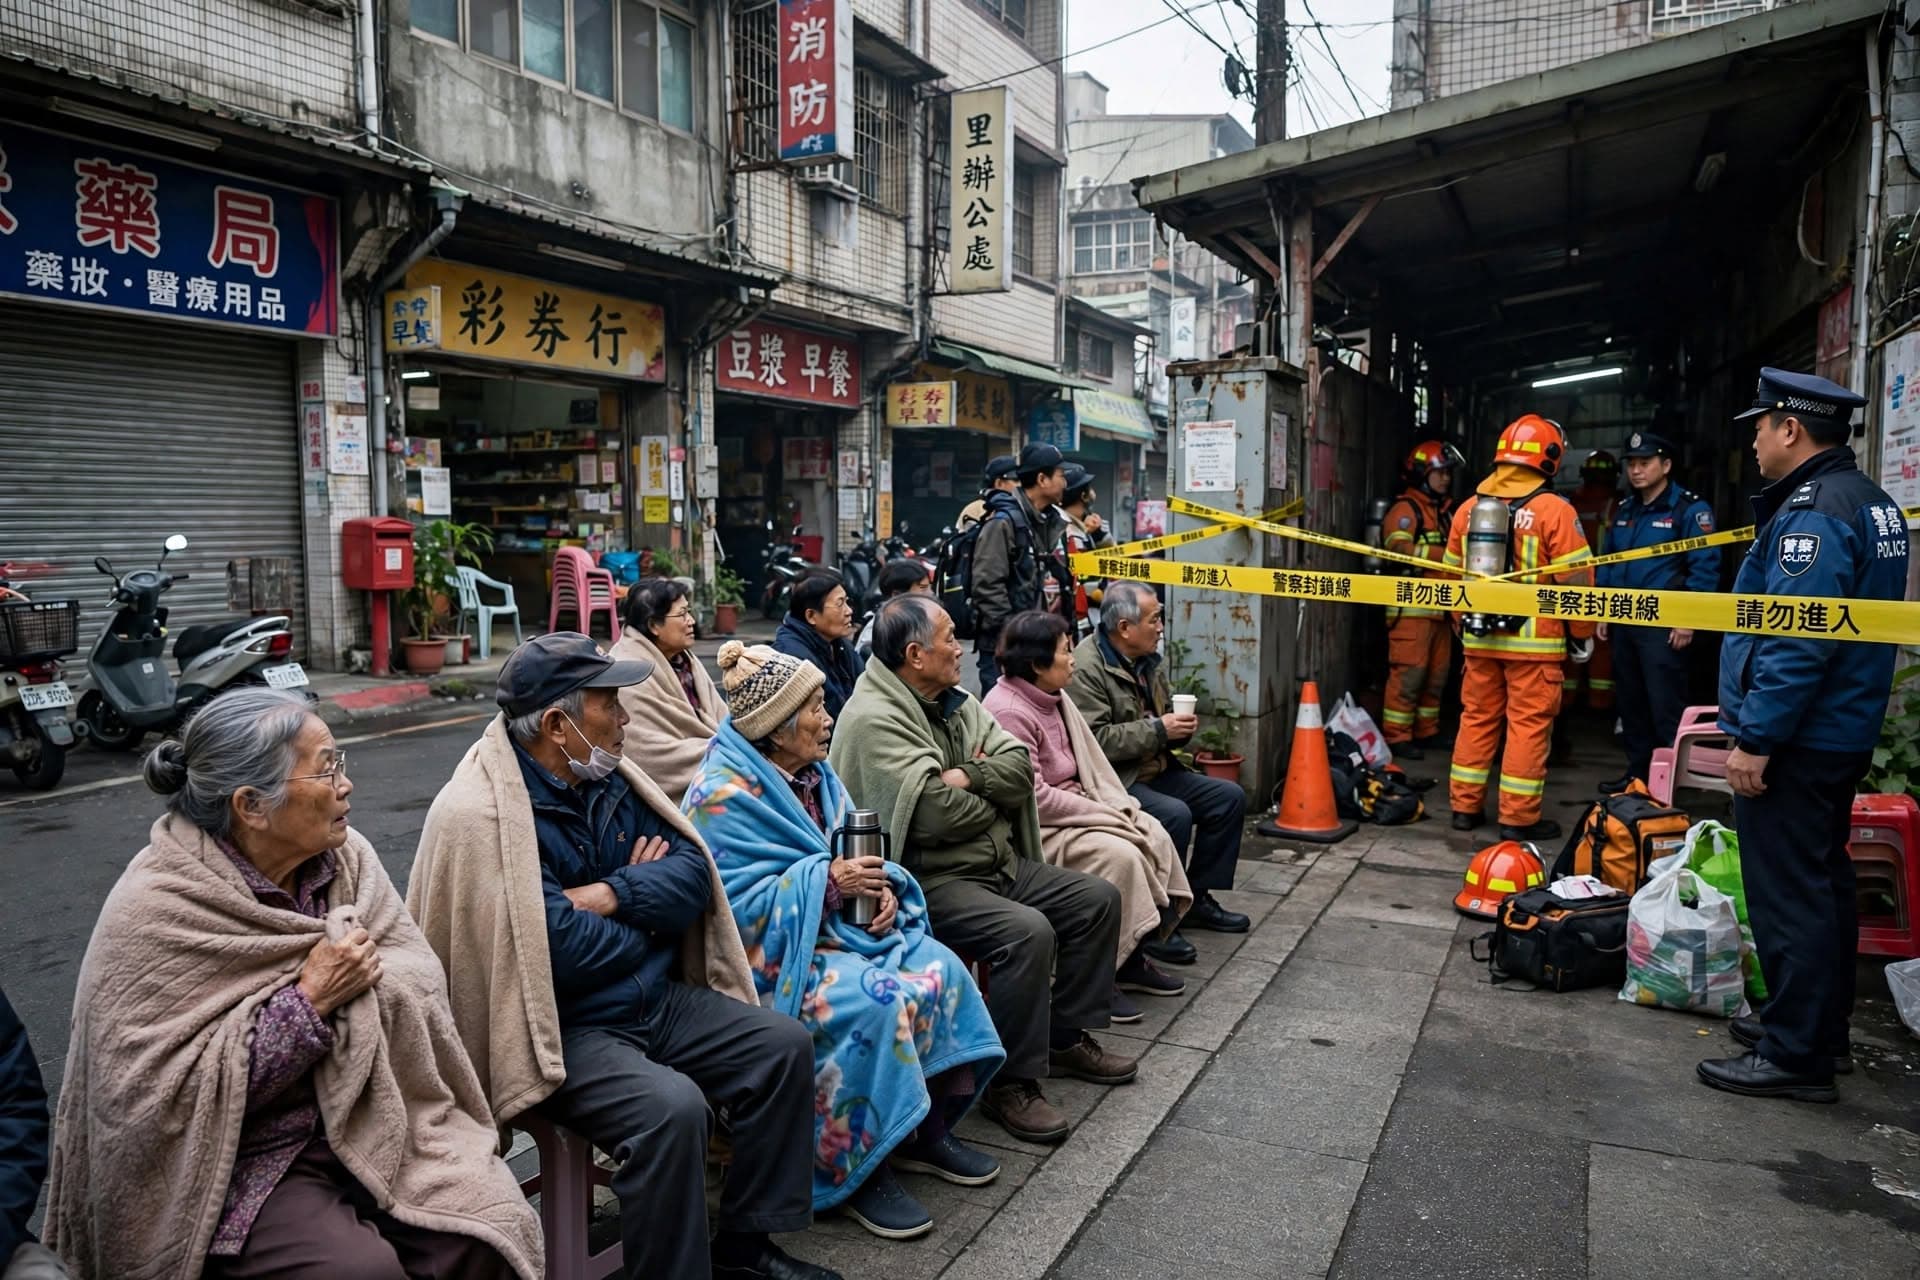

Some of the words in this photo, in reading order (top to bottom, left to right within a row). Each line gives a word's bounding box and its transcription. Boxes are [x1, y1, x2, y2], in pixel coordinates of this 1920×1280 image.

[788, 16, 829, 128] 消防
[962, 112, 996, 271] 里辦公處
[728, 330, 787, 388] 豆漿
[801, 343, 853, 398] 早餐
[1870, 506, 1902, 537] 警察
[1877, 541, 1906, 559] POLICE
[1781, 554, 1812, 563] POLICE
[1098, 559, 1151, 579] 警察封鎖線
[1182, 565, 1232, 587] 請勿進入
[1272, 571, 1352, 599] 警察封鎖線
[1396, 580, 1473, 608] 請勿進入
[1536, 589, 1660, 621] 警察封鎖線
[1736, 600, 1861, 635] 請勿進入
